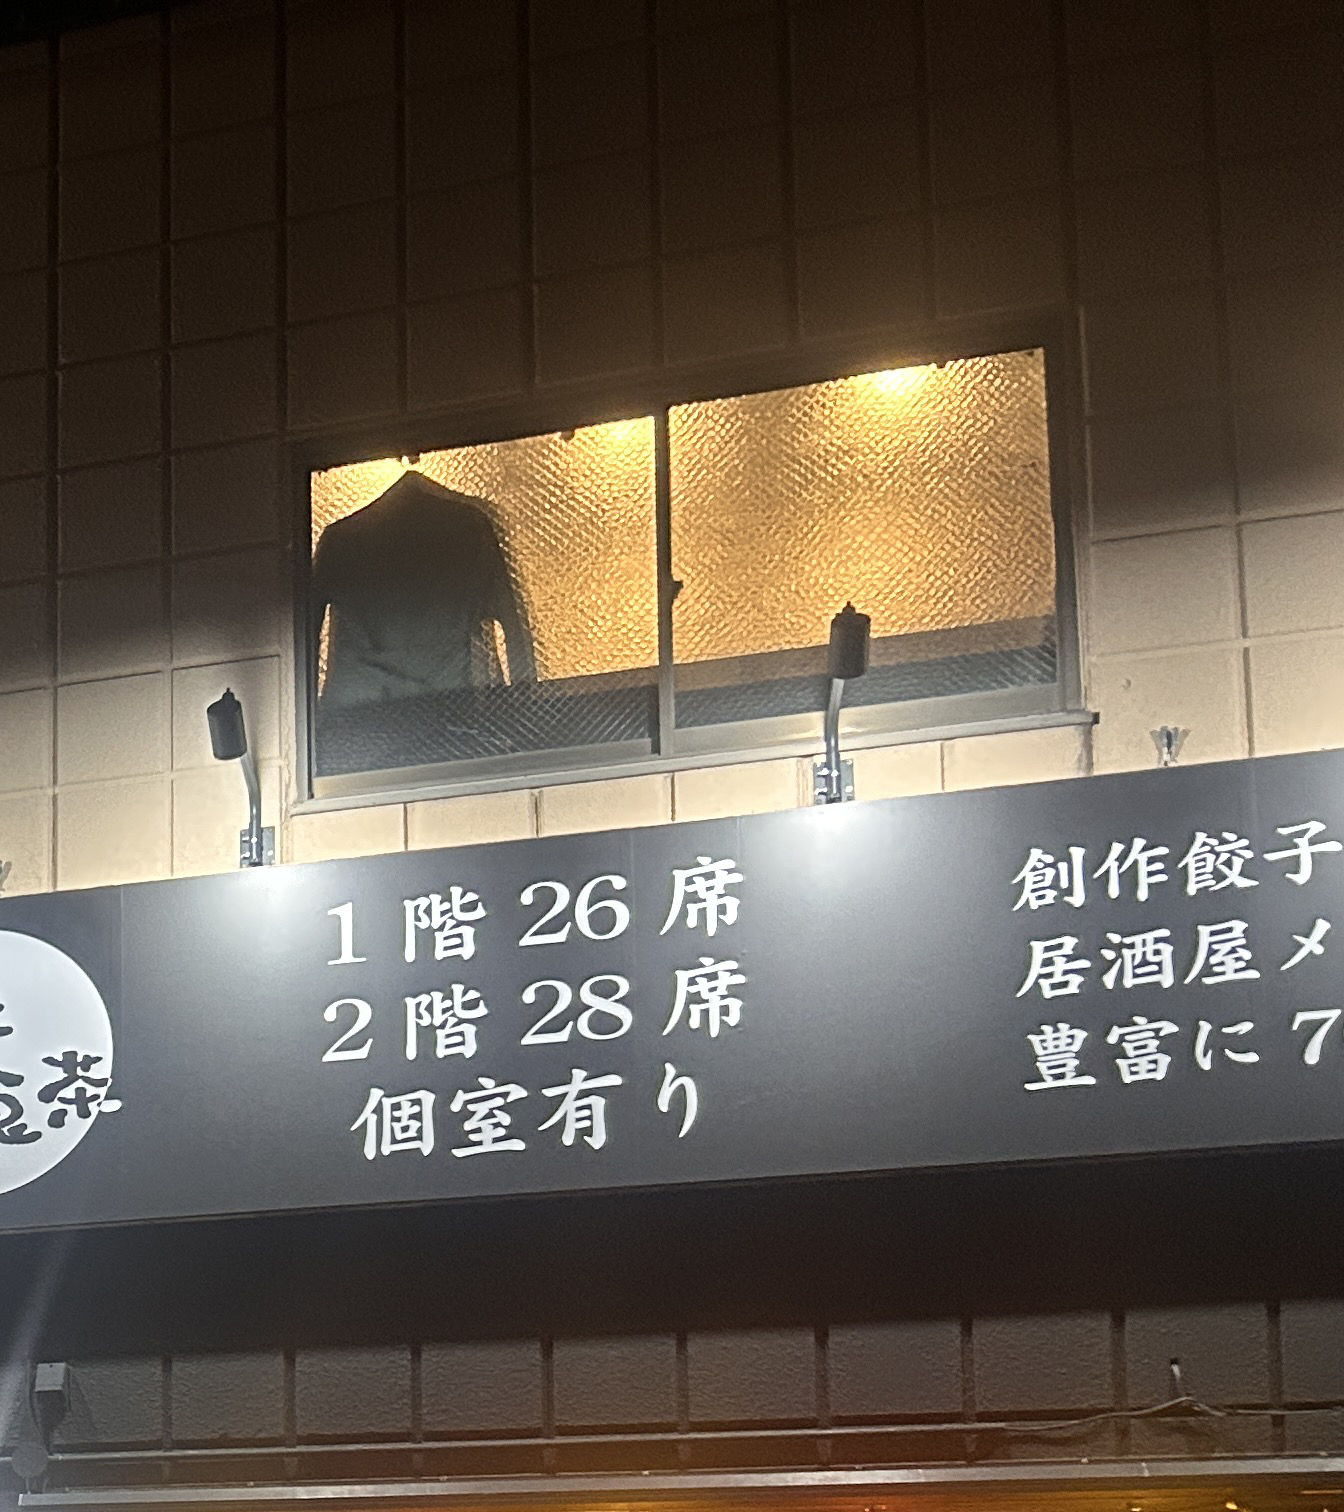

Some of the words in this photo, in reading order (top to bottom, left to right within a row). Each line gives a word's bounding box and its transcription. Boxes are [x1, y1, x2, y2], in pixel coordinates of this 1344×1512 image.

[1012, 820, 1344, 911] 創作餃子
[1015, 917, 1333, 1000] 居酒屋メ
[350, 1063, 699, 1161] 個室有り
